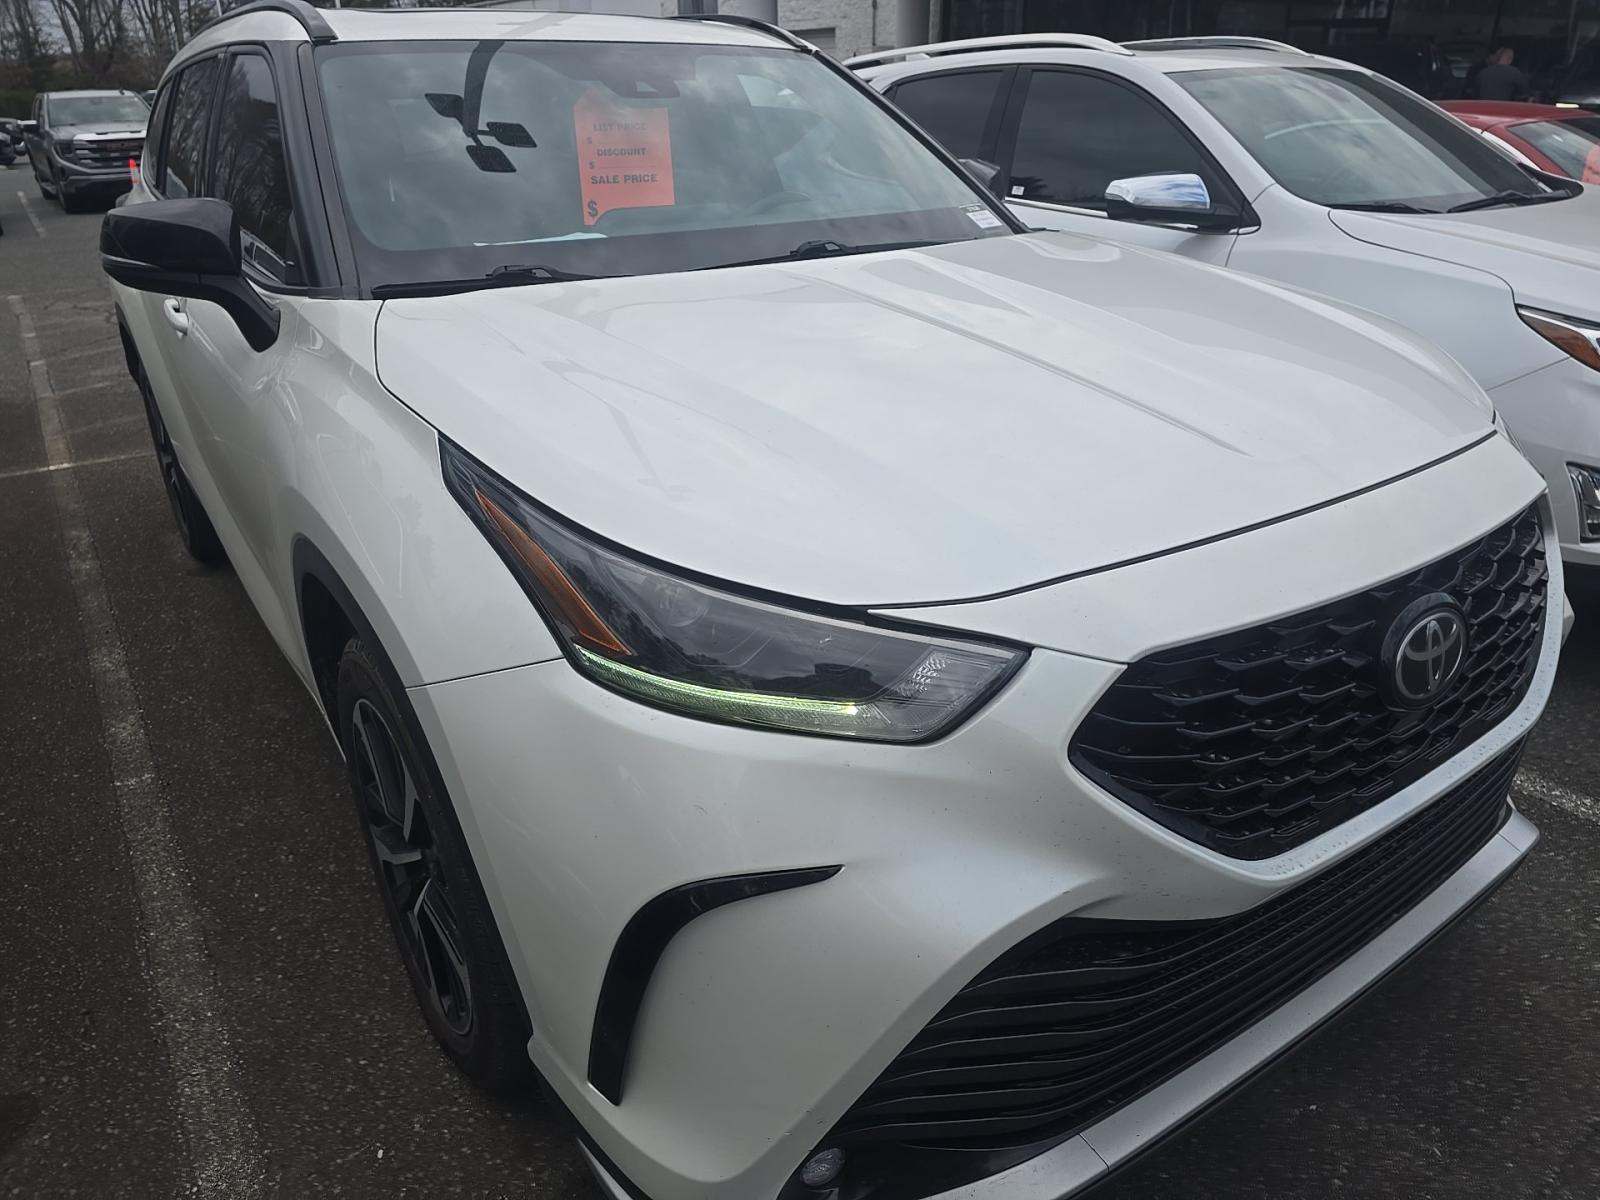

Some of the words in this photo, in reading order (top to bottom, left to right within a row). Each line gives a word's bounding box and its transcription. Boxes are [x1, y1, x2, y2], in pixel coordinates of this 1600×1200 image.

[597, 147, 648, 157] DISCOUNT
[590, 174, 620, 185] SALE
[623, 173, 658, 184] PRICE
[587, 198, 599, 220] $
